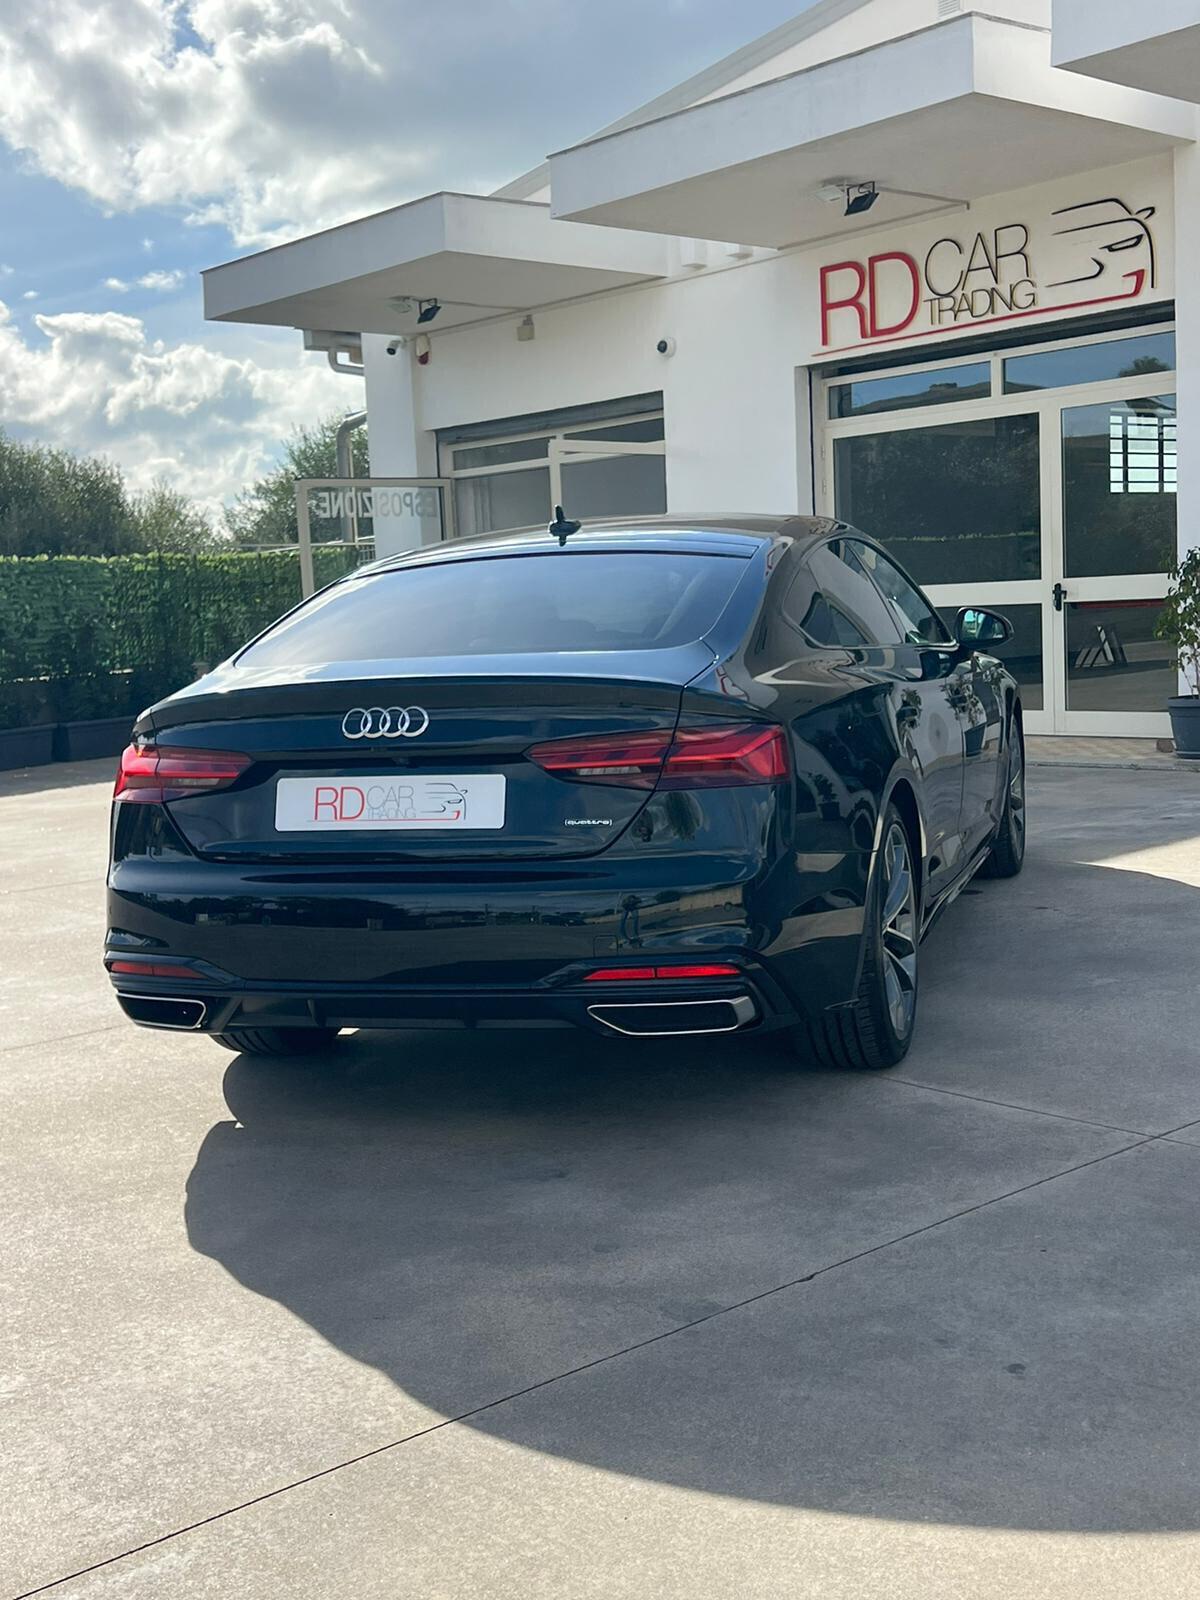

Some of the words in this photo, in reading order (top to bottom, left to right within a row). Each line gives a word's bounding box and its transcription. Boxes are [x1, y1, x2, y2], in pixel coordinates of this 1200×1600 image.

[820, 252, 921, 346] RD
[924, 224, 1031, 296] CAR
[923, 279, 1037, 326] TRADING
[314, 786, 365, 821] RD
[366, 785, 415, 809] CAR
